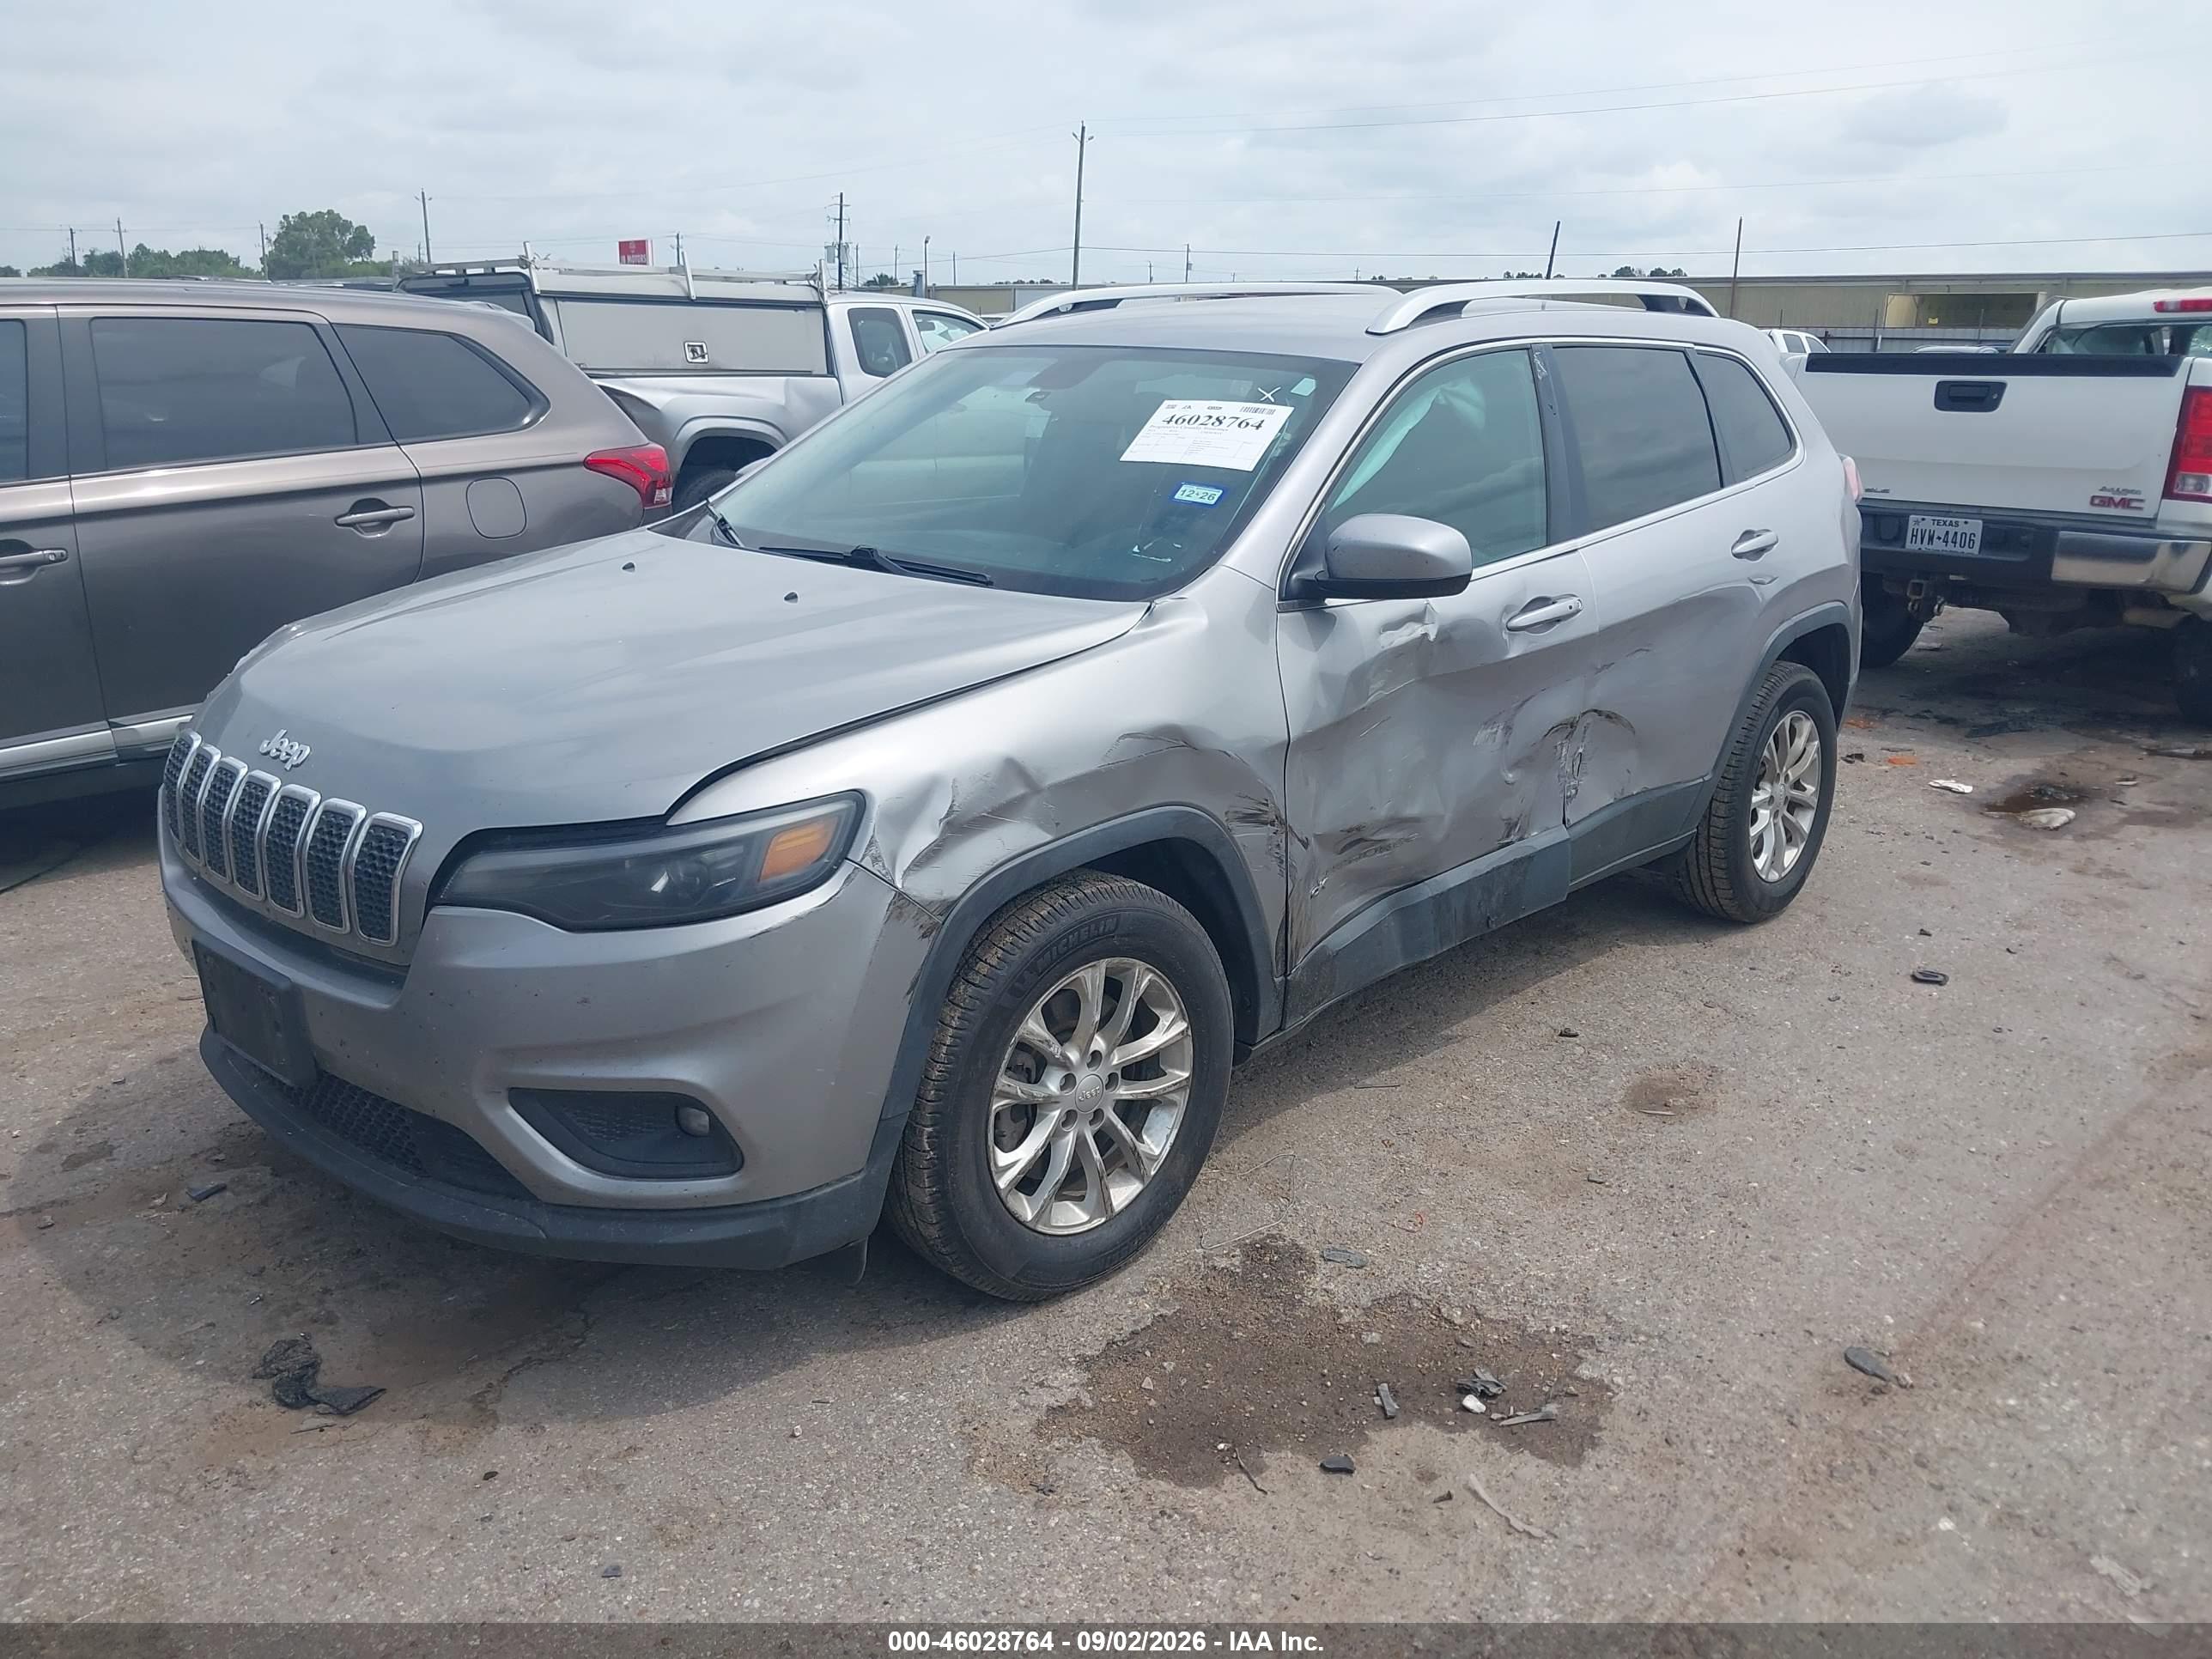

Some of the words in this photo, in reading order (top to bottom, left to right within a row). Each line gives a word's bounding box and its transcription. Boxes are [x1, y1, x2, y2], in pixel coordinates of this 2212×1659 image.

[1162, 413, 1265, 430] 46028764
[2089, 495, 2145, 511] GMC
[1930, 519, 1960, 528] TEXAS
[259, 729, 311, 770] Jeep
[1036, 917, 1119, 974] MICHELIN
